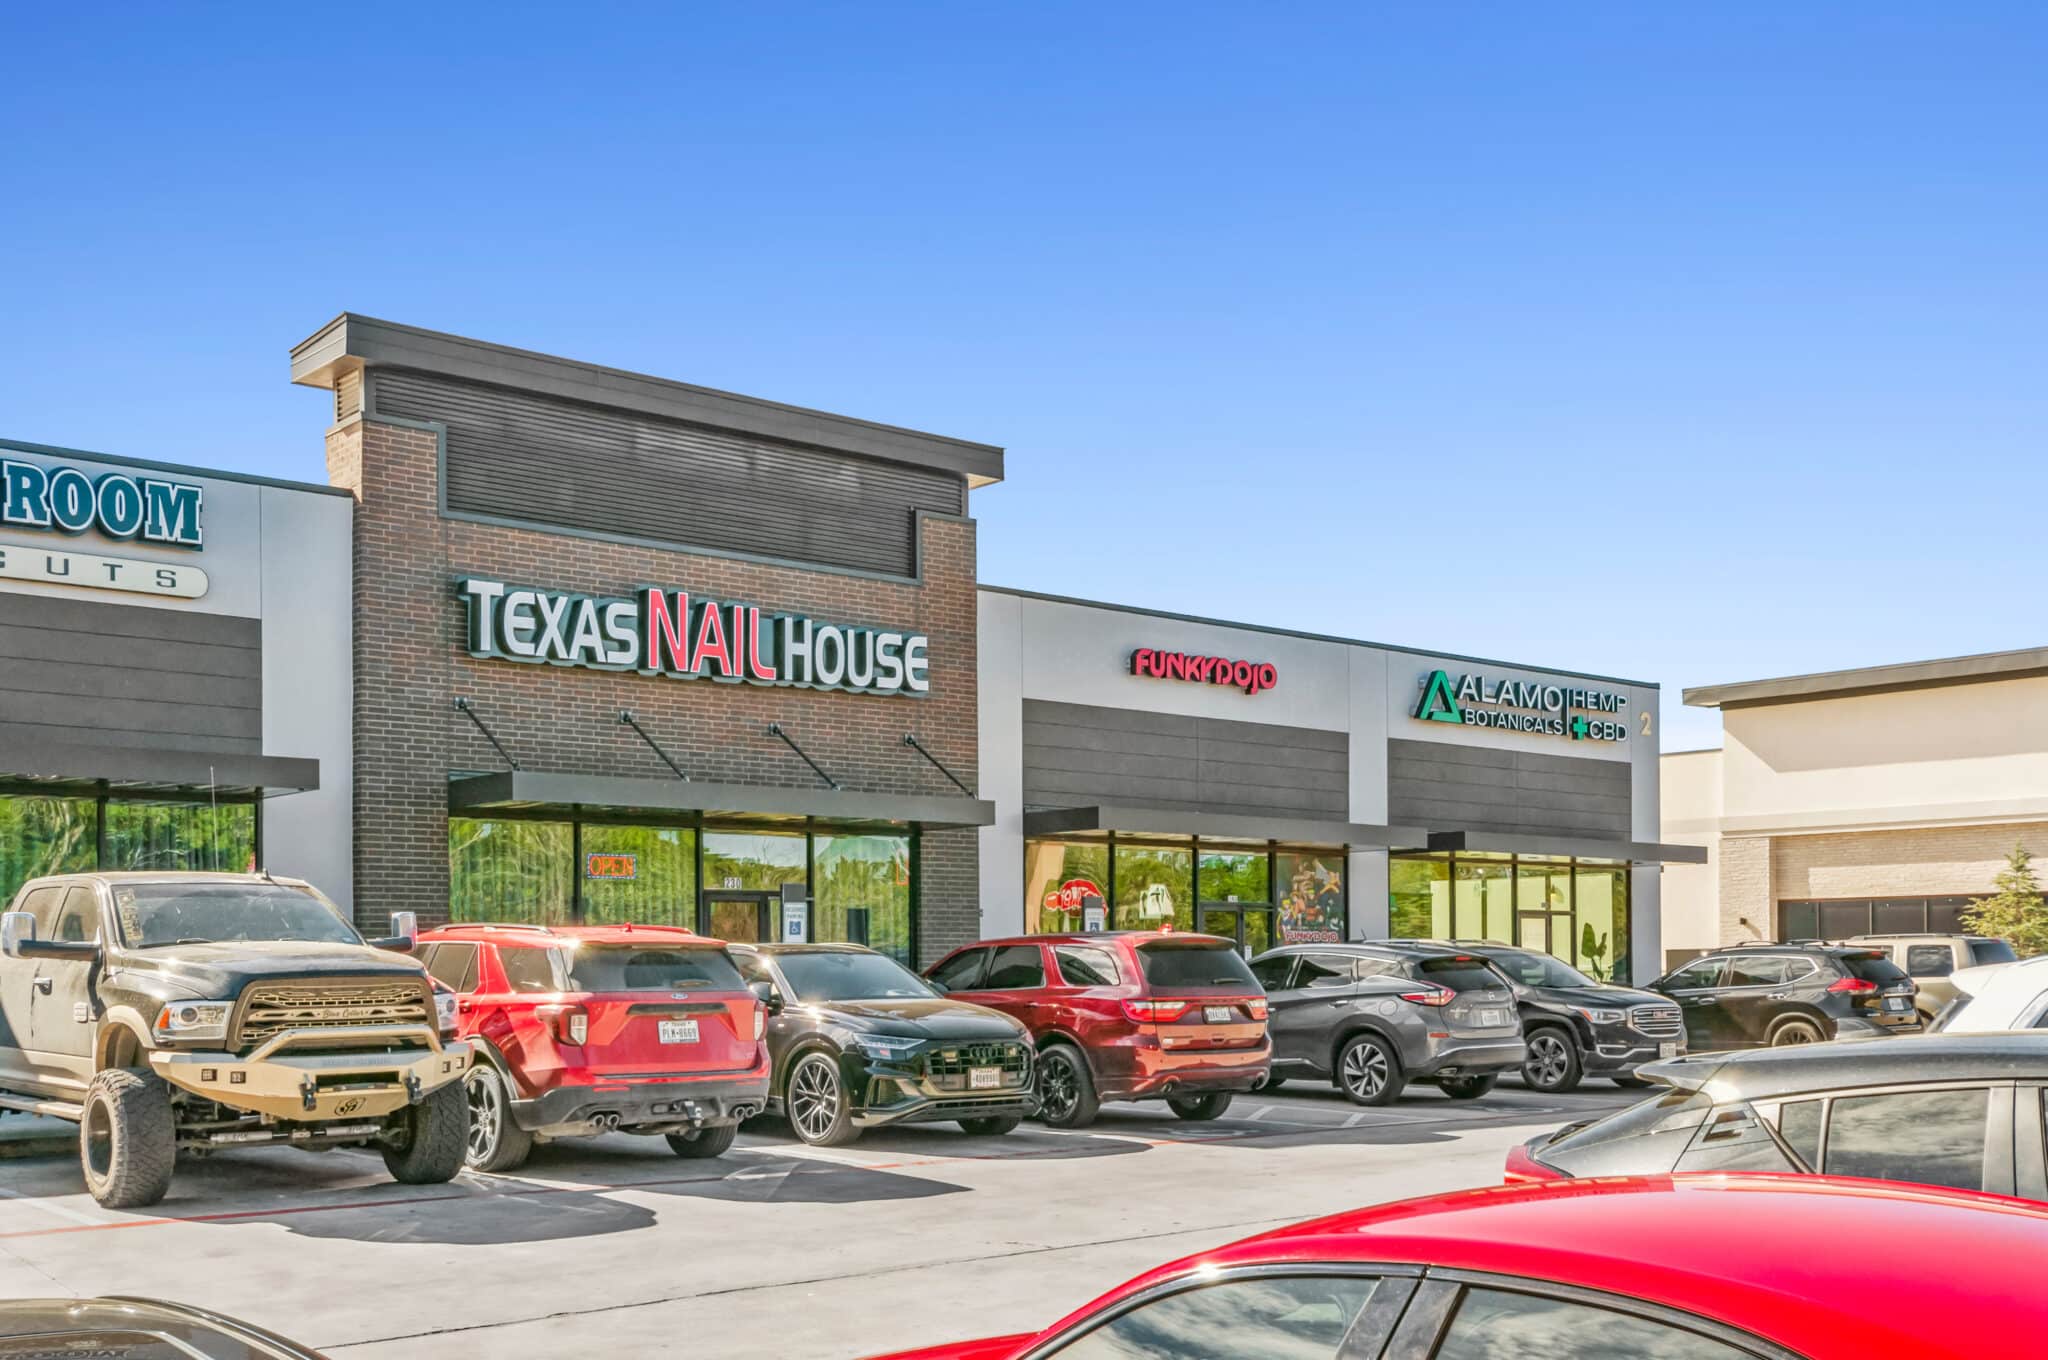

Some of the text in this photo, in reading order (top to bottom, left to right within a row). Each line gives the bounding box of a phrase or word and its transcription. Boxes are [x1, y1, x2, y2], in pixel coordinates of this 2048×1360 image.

[2, 460, 203, 545] ROOM
[0, 551, 177, 588] UTS
[466, 579, 929, 692] TEXAS NAIL HOUSE
[1458, 673, 1564, 712] ALAMO
[1572, 688, 1628, 713] HEMP
[1464, 708, 1563, 736] BOTANICALS
[1639, 711, 1653, 736] 2
[590, 855, 634, 876] OPEN
